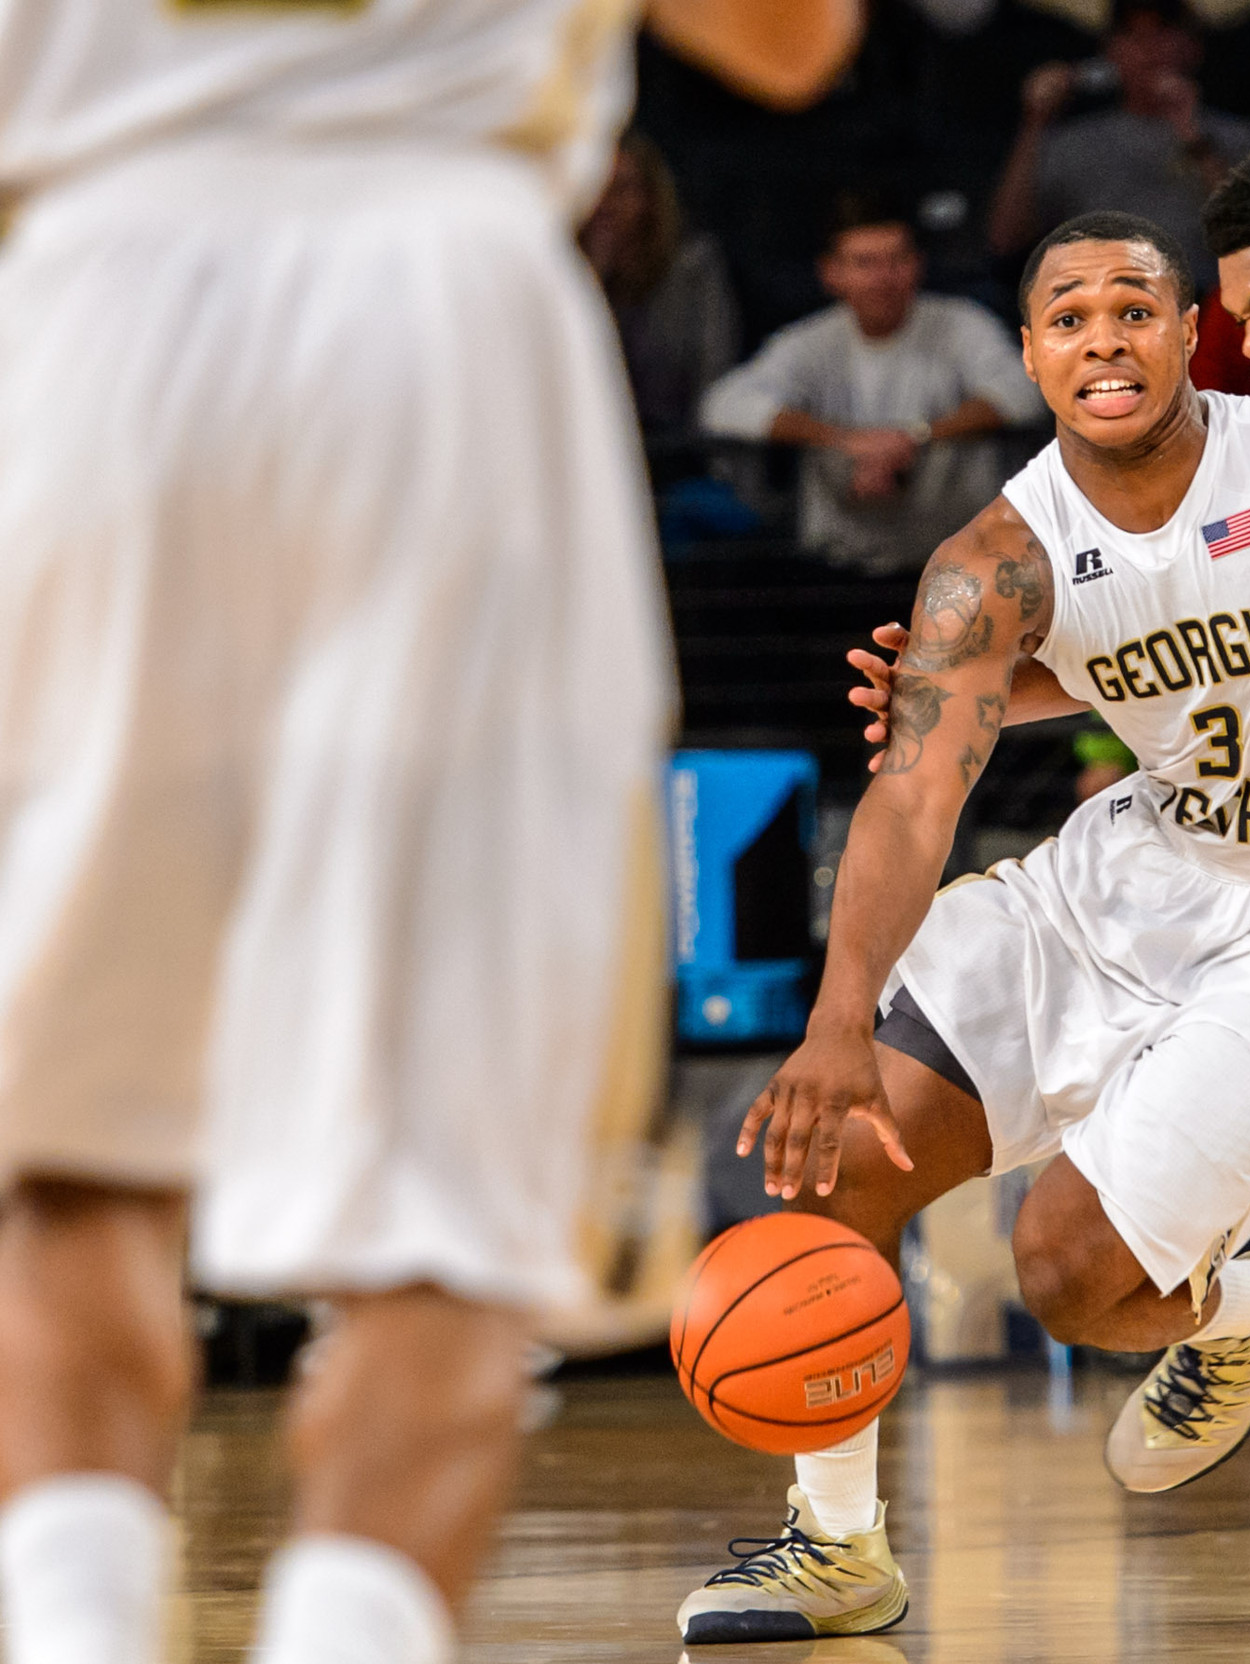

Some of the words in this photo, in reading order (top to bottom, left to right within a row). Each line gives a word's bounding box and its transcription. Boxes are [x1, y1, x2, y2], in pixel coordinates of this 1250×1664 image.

[1076, 548, 1102, 575] R
[1189, 704, 1243, 782] 3
[804, 1345, 895, 1409] ELITE
